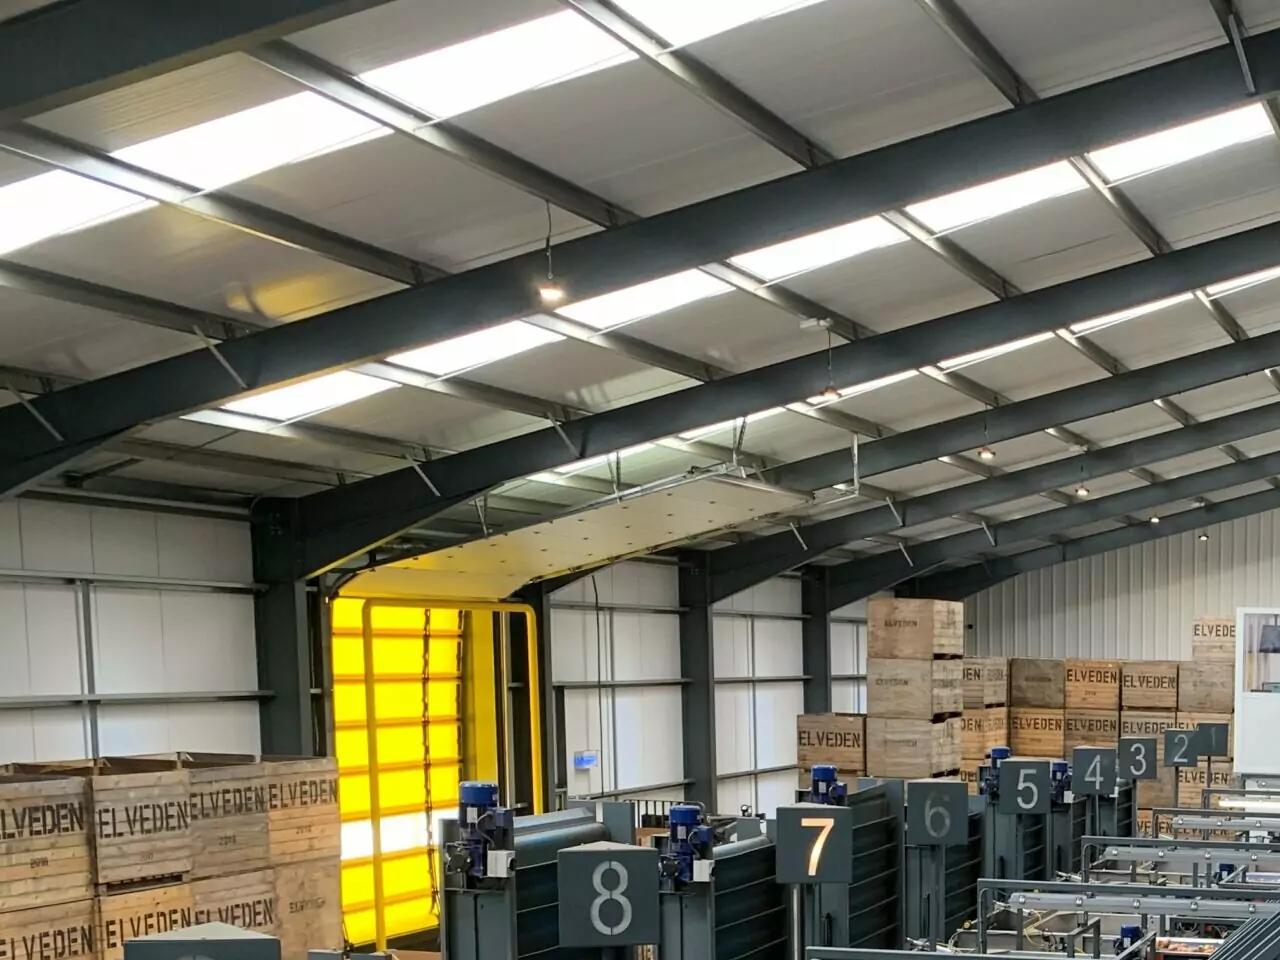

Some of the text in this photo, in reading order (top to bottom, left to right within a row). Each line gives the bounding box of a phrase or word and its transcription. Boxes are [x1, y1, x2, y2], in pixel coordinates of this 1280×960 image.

[1194, 624, 1236, 638] ELVEDE
[1066, 669, 1117, 684] ELVEDEN
[1123, 674, 1176, 689] ELVEDEN
[799, 730, 861, 749] ELVEDEN
[1013, 717, 1062, 731] ELVEDEN
[1066, 718, 1117, 732] ELVEDEN
[1129, 743, 1147, 776] 3
[1172, 734, 1188, 763] 2
[1016, 768, 1039, 810] 5
[1084, 754, 1104, 791] 4
[189, 786, 266, 820] ELVEDEN
[268, 778, 338, 810] ELVEDEN
[0, 801, 84, 840] LVEDEN
[98, 801, 190, 839] ELVEDEN
[924, 791, 951, 839] 6
[800, 817, 835, 877] 7
[590, 860, 633, 936] 8
